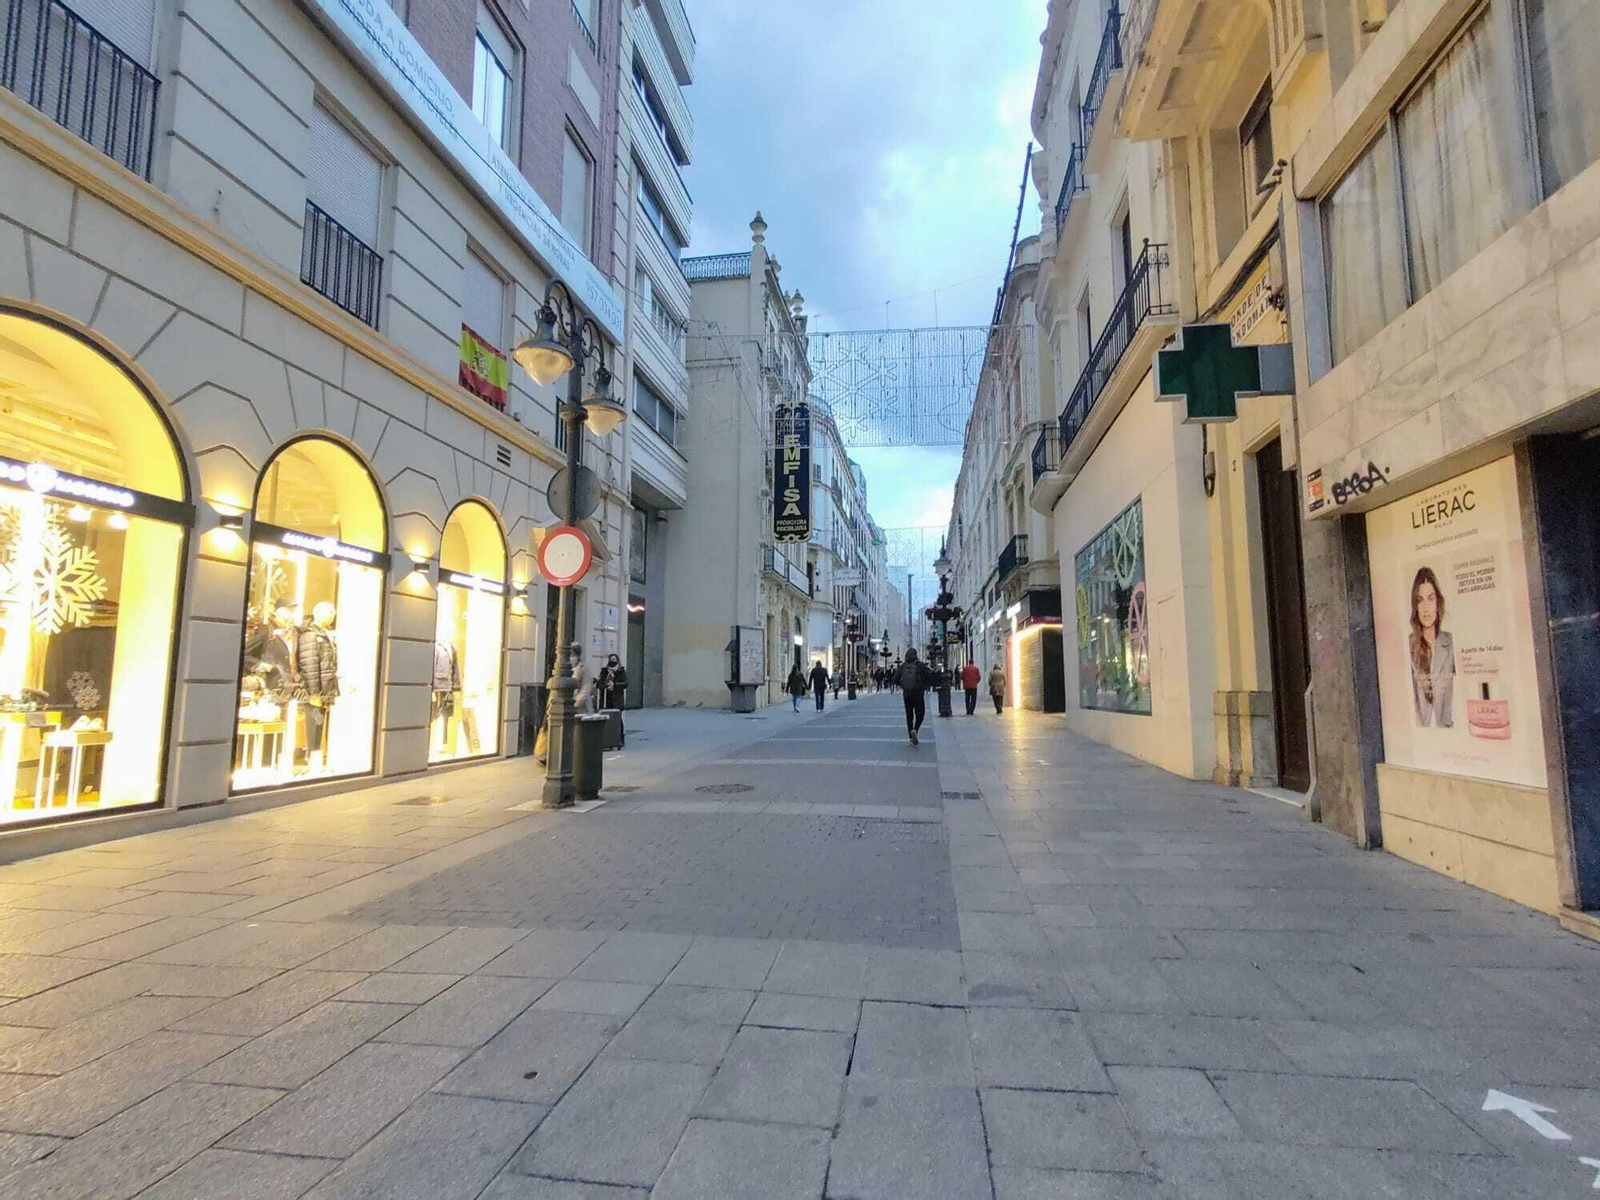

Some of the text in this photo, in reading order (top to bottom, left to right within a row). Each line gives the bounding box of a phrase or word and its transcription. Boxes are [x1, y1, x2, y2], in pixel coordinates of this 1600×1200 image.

[386, 28, 396, 46] A
[1231, 293, 1252, 327] ONDE
[782, 434, 802, 517] EMFISA
[1411, 490, 1476, 529] LIERAC
